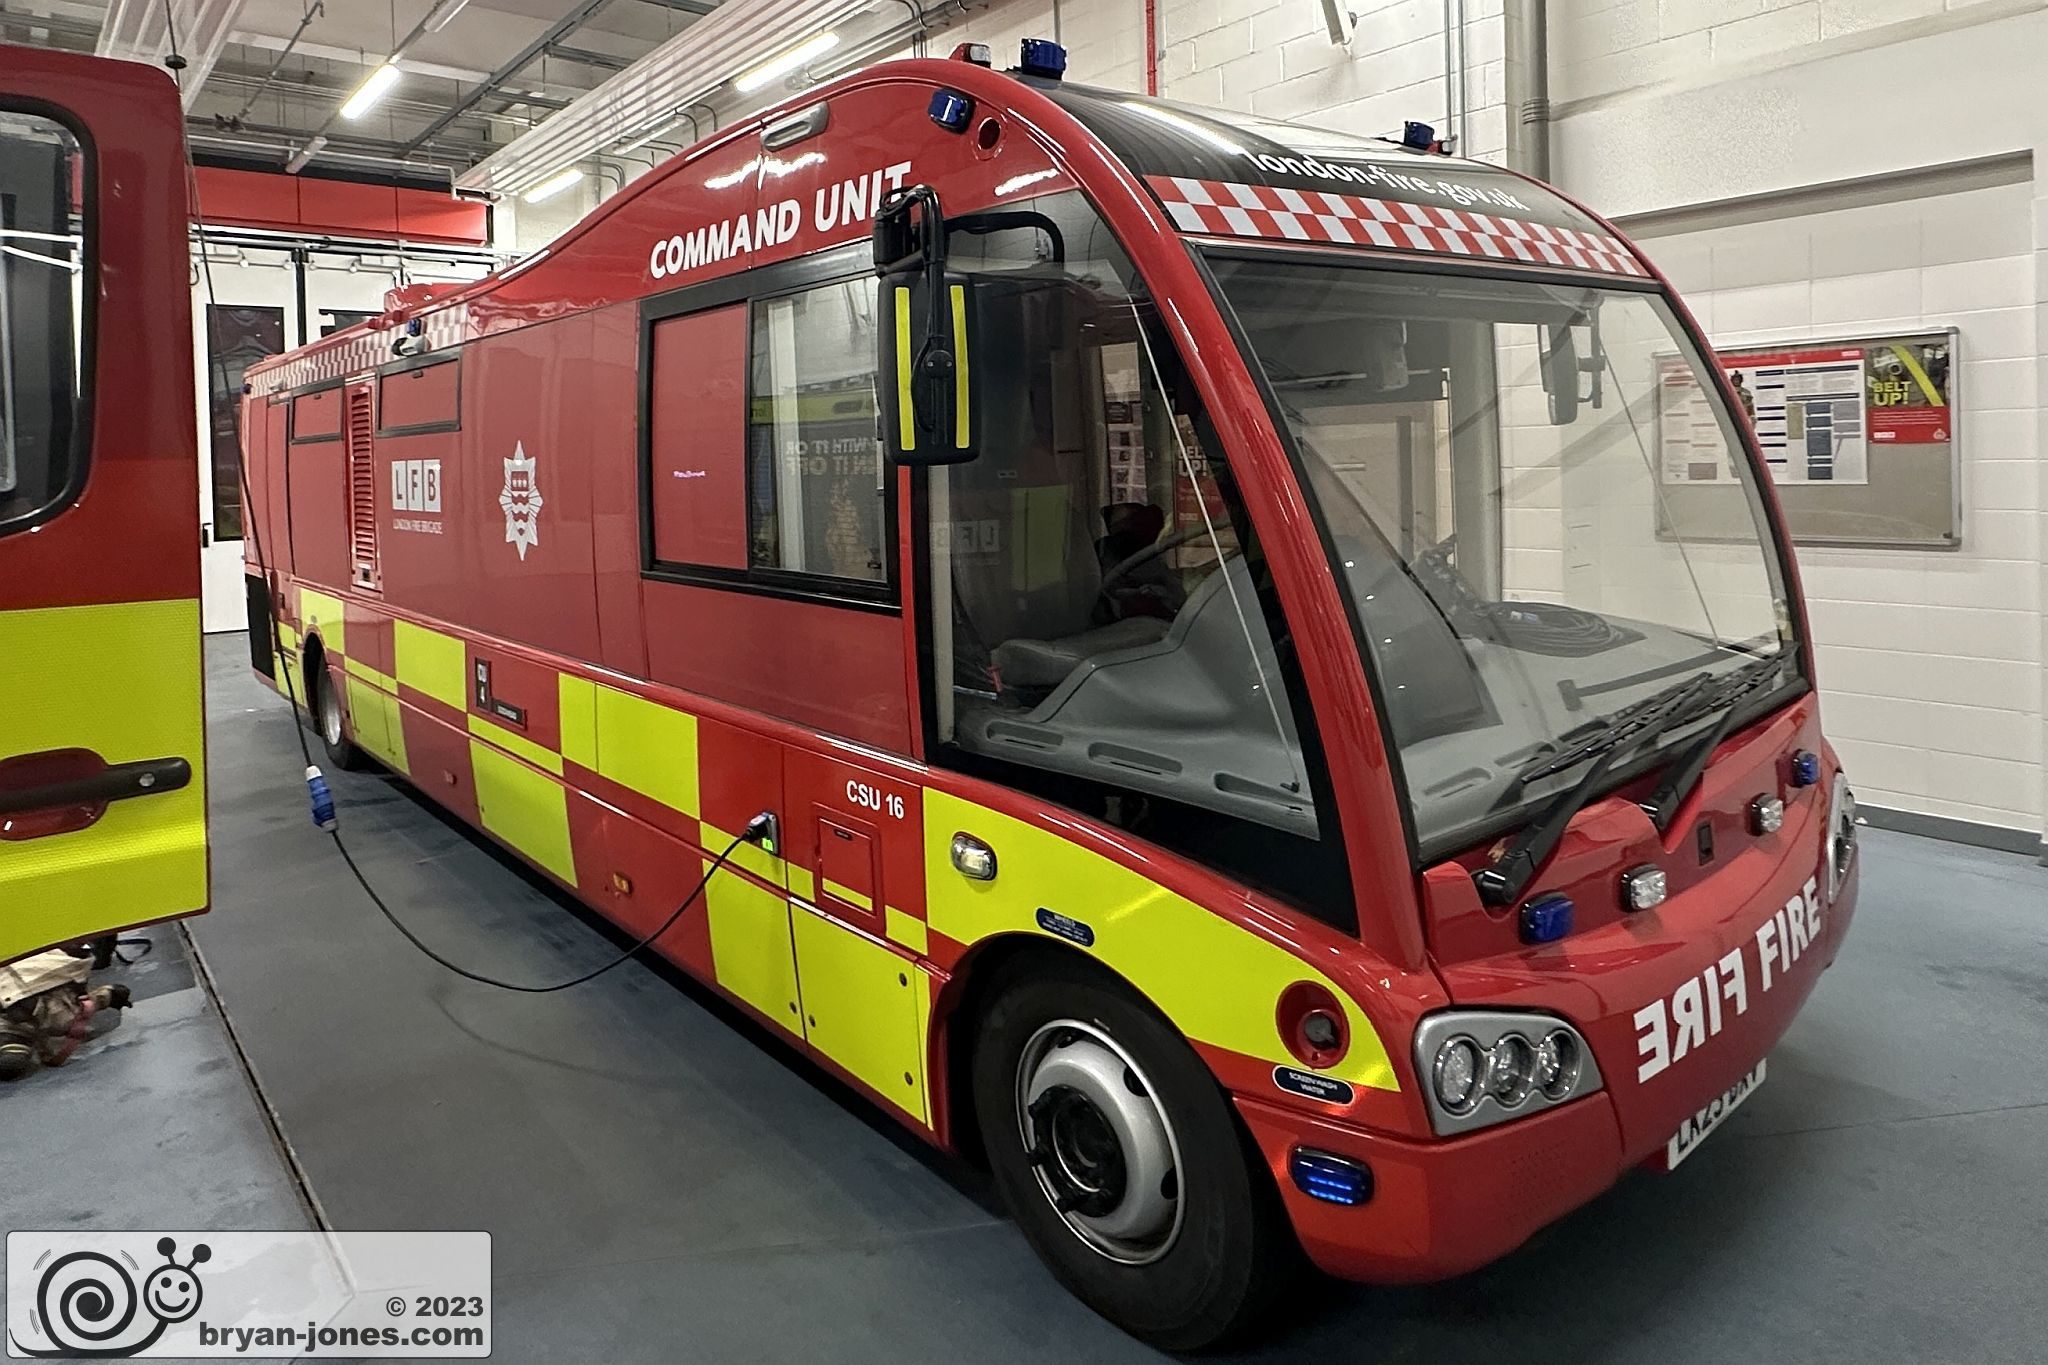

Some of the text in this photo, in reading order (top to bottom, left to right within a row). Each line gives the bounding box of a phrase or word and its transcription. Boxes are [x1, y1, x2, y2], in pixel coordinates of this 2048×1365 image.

[1244, 150, 1531, 212] london-fire.gov.uk
[650, 161, 912, 279] COMMAND UNIT
[1873, 381, 1912, 392] BELT
[1874, 392, 1909, 405] UP!
[394, 466, 439, 504] LFB
[846, 780, 904, 819] CSU 16
[1755, 875, 1822, 992] FIRE
